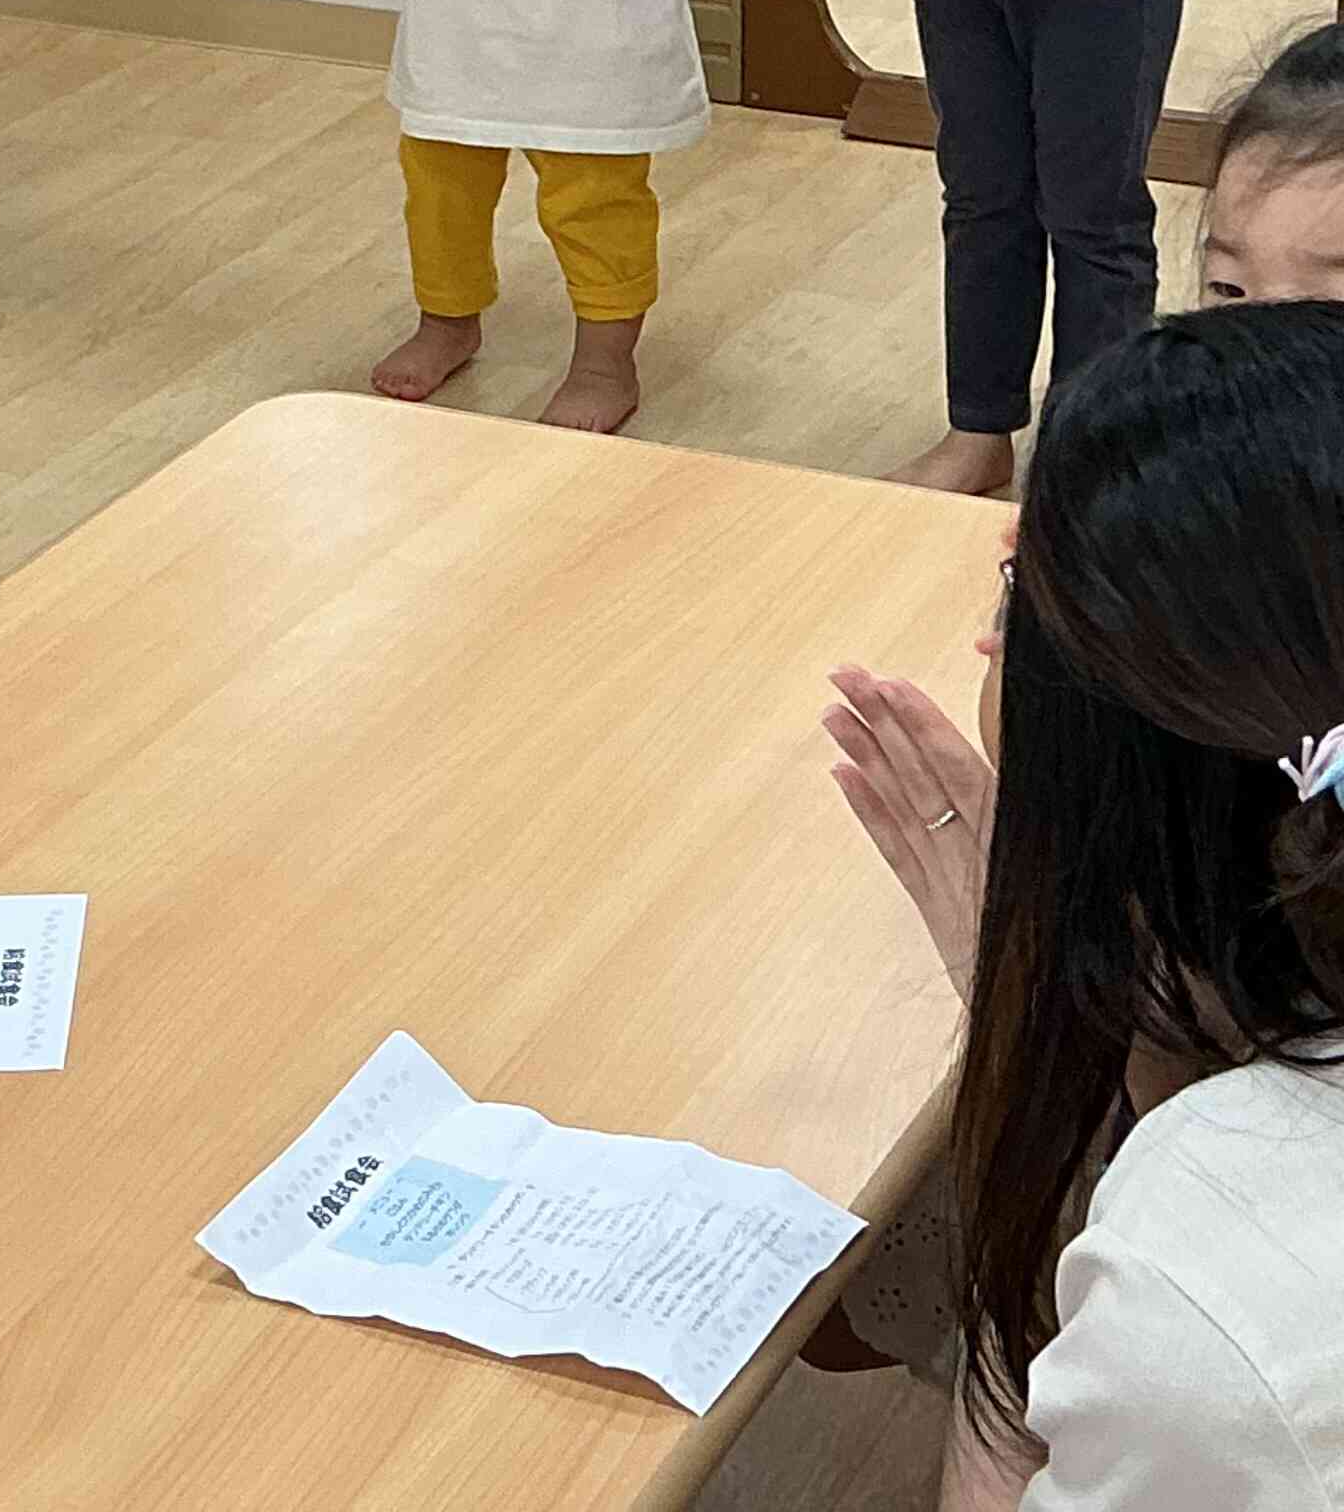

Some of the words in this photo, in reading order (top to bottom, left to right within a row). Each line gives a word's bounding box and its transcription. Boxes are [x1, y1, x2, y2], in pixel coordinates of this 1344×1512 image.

[307, 1155, 384, 1229] 給食試食会
